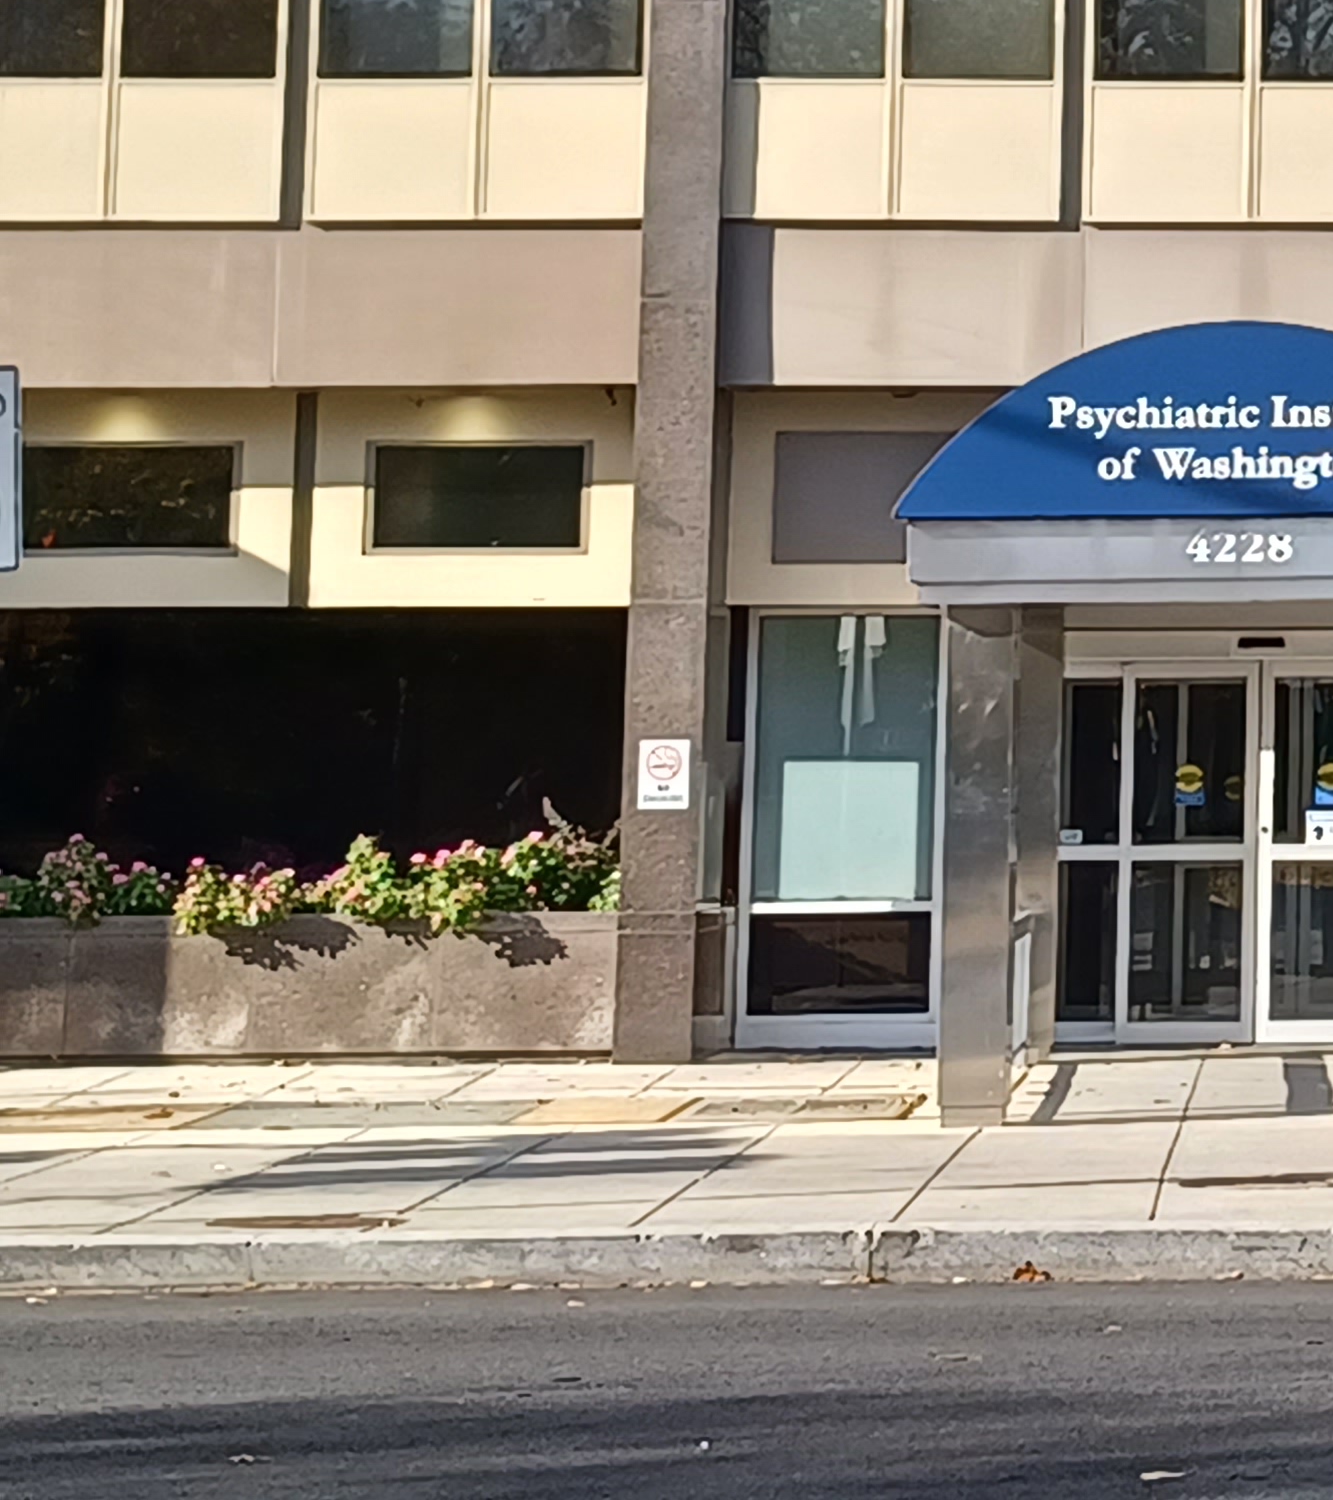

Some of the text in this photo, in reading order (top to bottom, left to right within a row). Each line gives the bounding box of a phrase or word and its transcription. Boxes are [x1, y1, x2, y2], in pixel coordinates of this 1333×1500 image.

[1048, 396, 1260, 439] Psychiatric
[1097, 447, 1141, 480] of
[1185, 531, 1294, 563] 4228
